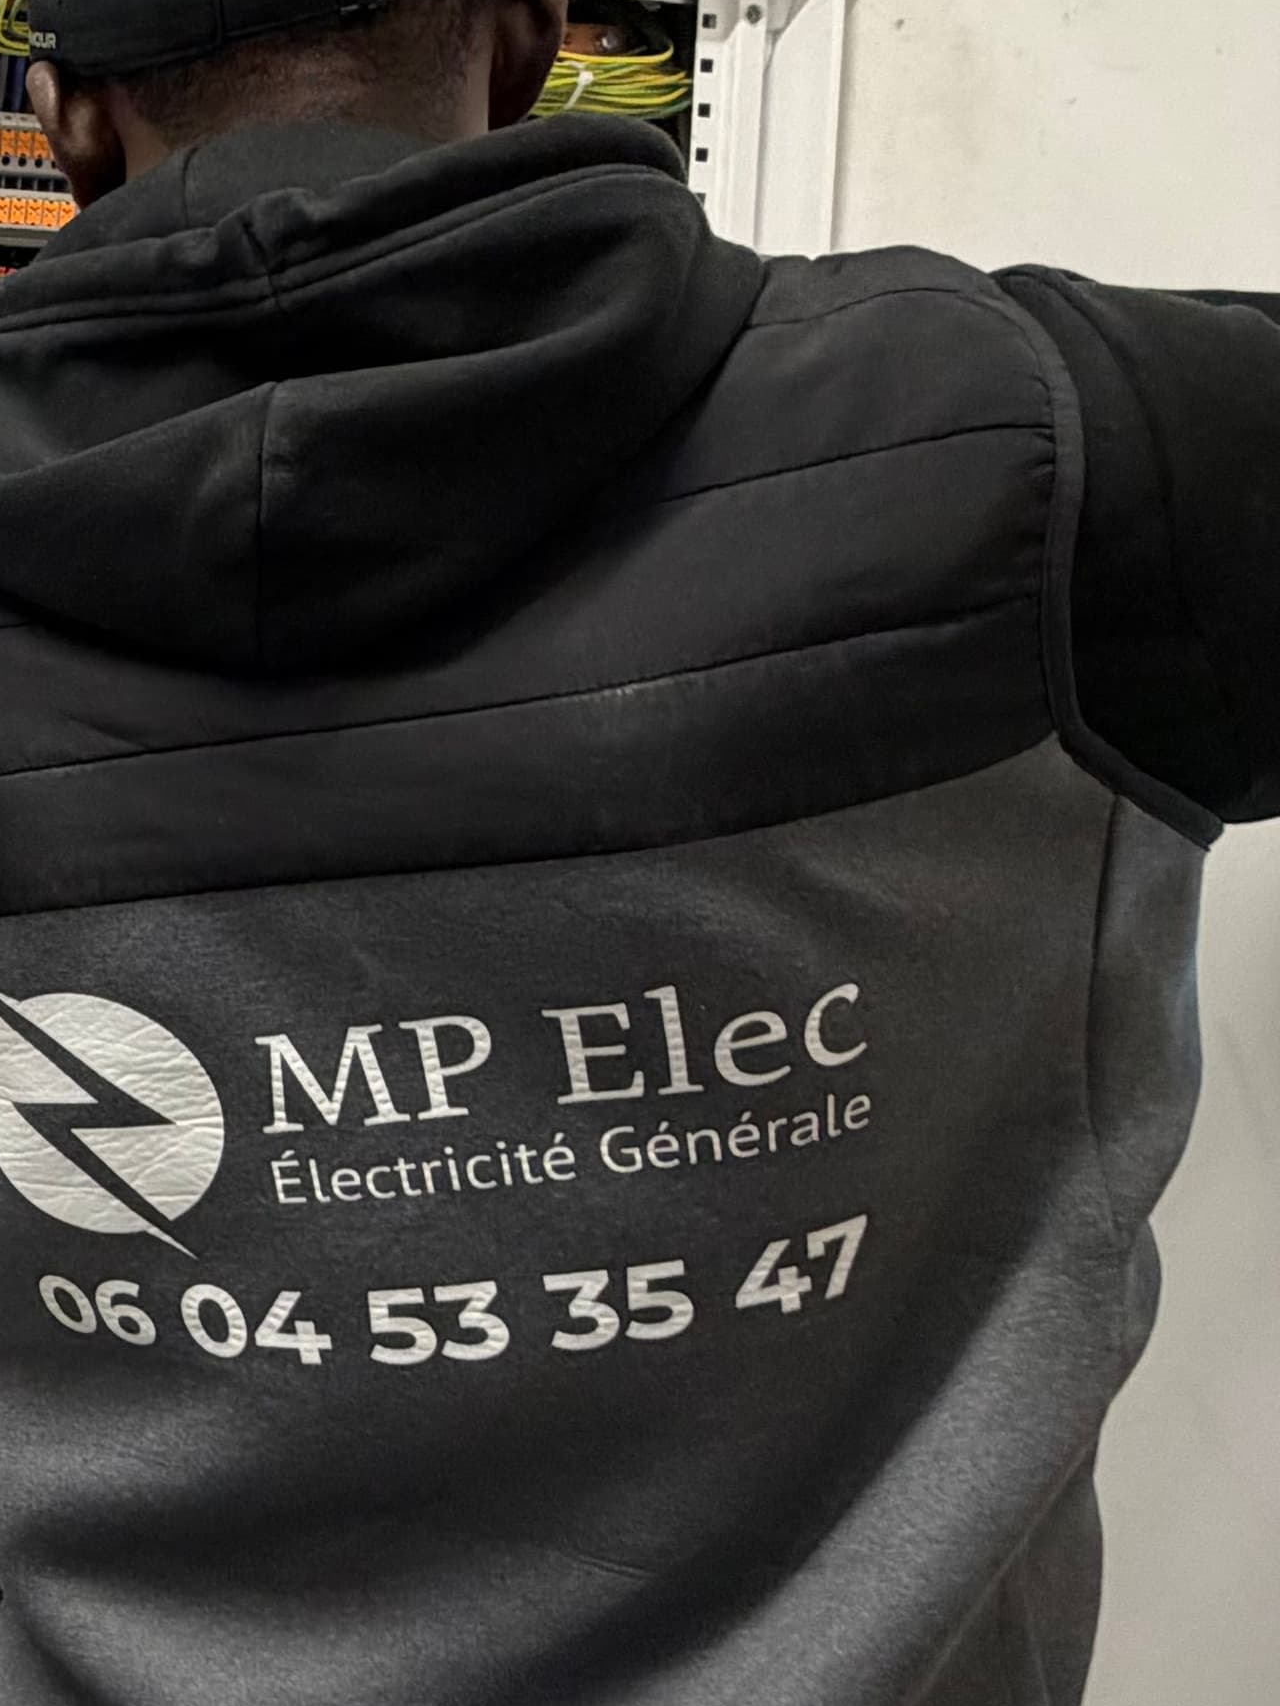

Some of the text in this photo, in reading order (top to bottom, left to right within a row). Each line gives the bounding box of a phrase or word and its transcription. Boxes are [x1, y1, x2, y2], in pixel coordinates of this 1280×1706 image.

[254, 983, 868, 1134] MP Elec
[271, 1094, 871, 1204] Électricité Générale
[38, 1214, 868, 1365] 06 04 53 35 47
